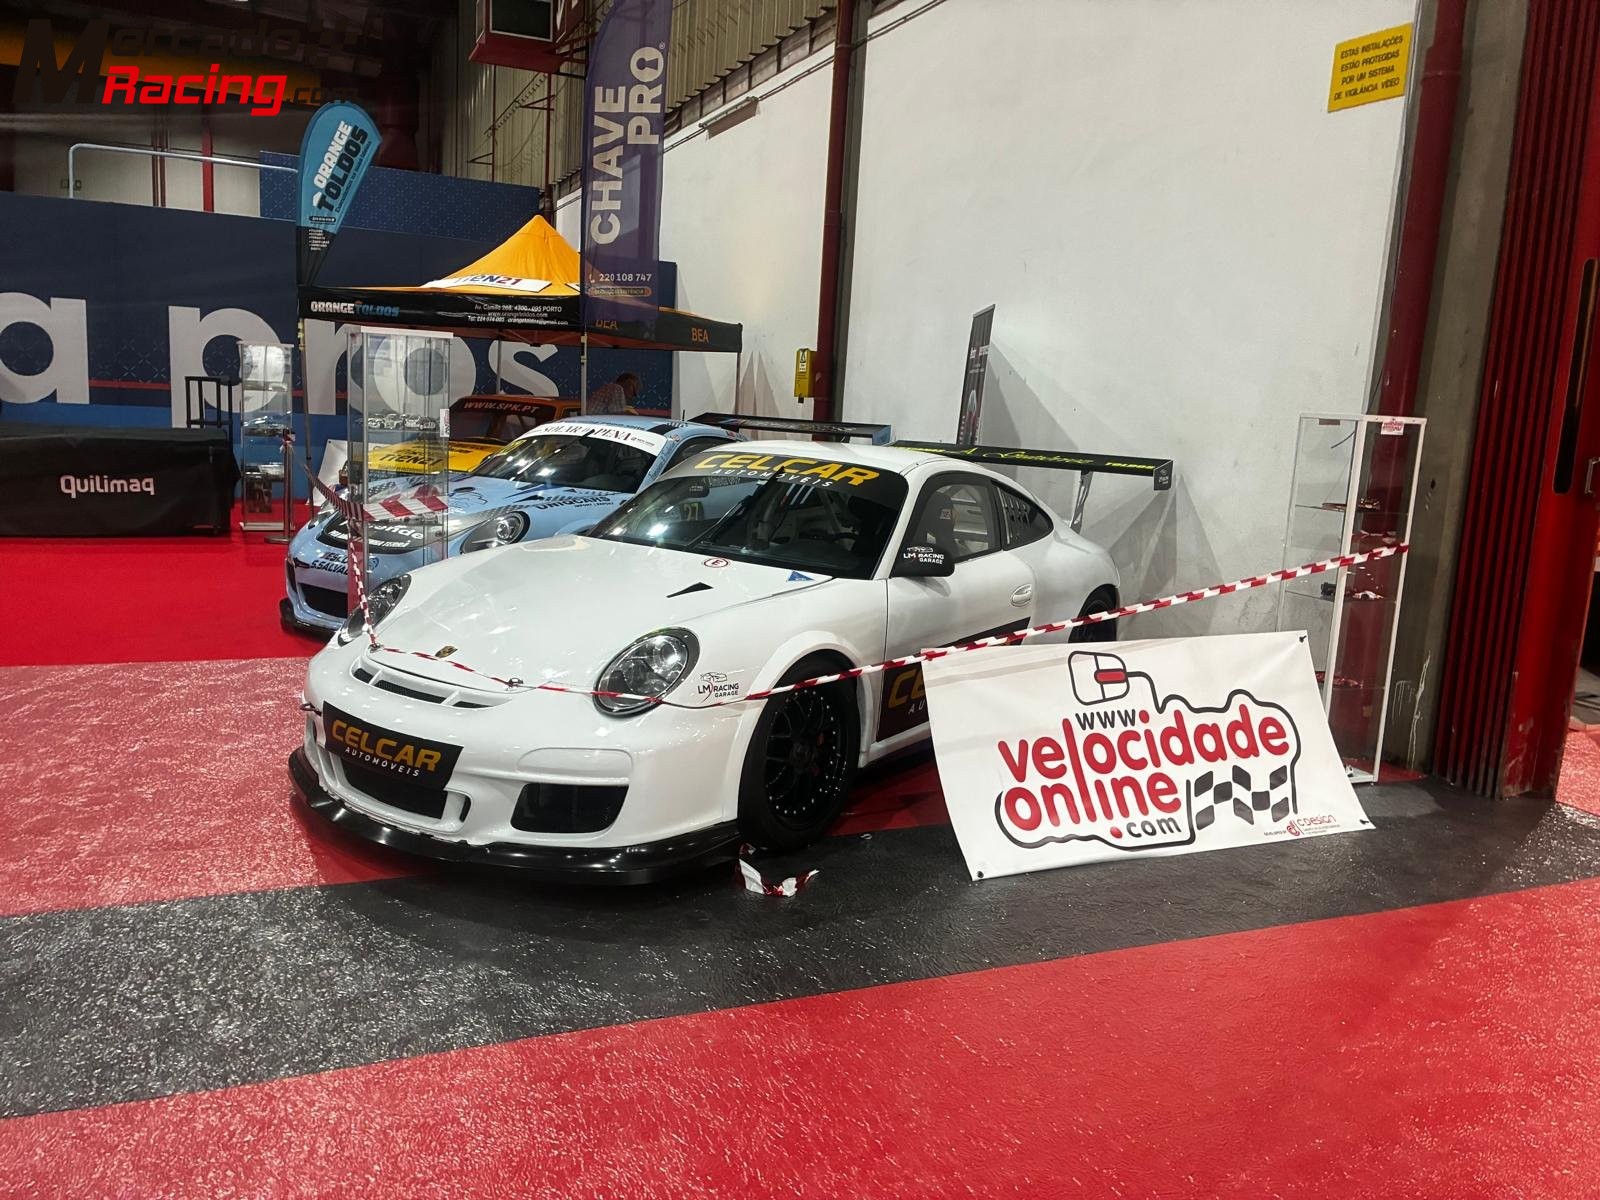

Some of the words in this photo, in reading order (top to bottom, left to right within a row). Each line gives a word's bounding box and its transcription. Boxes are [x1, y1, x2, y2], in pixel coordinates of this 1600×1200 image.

[1340, 47, 1360, 59] ESTAS
[1361, 49, 1400, 65] PROTEGIDAS
[1341, 77, 1355, 85] POR
[1356, 72, 1366, 81] UM
[1368, 65, 1394, 78] SISTEMA
[627, 46, 664, 145] PRO
[1333, 92, 1342, 101] DE
[313, 120, 352, 189] ORANGE
[316, 125, 369, 212] TOLDOS
[590, 86, 626, 245] CHAVE
[599, 273, 615, 282] 220
[616, 273, 633, 282] 108
[635, 273, 652, 282] 747
[691, 327, 709, 343] BEA
[463, 402, 540, 413] WWW.SPK.PT
[694, 454, 880, 486] CELCAR
[537, 496, 611, 510] UNIQCARS
[919, 557, 943, 565] GARAGE
[697, 684, 711, 694] LM
[713, 683, 740, 693] RACING
[714, 690, 739, 698] GARAGE
[331, 719, 442, 772] CELCAR
[998, 704, 1290, 790] velocidade
[1004, 770, 1181, 830] online
[1110, 816, 1181, 839] .com
